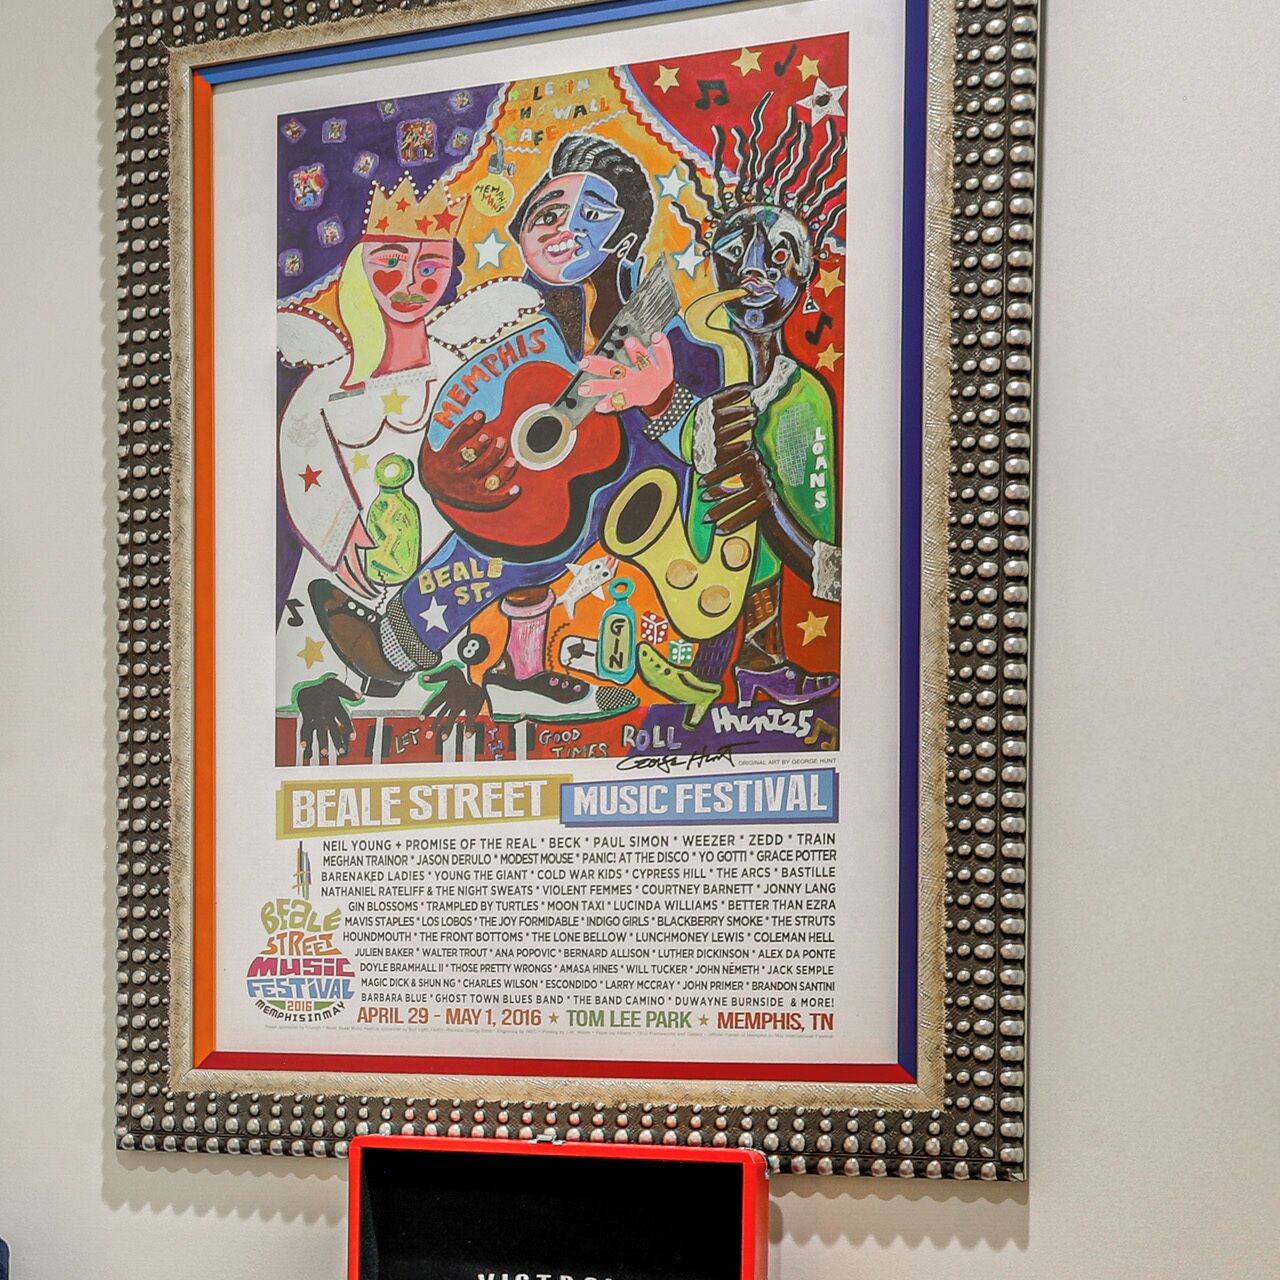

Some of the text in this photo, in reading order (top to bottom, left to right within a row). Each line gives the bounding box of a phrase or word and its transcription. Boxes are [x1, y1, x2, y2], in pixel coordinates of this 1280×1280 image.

[432, 328, 546, 429] MEMPHIS
[810, 426, 828, 509] LOANS
[418, 556, 504, 595] BEALE
[454, 582, 493, 606] ST.
[462, 639, 480, 659] 8
[609, 618, 627, 669] GIN
[394, 728, 421, 754] LET
[539, 725, 682, 751] GOOD ROLL
[292, 773, 828, 829] BEALE STREET MUSIC FESTIVAL
[322, 840, 348, 851] NEIL
[351, 840, 392, 851] YOUNG
[405, 839, 456, 850] PROMISE
[459, 839, 476, 849] OF
[479, 838, 502, 849] THE
[506, 838, 537, 849] REAL
[548, 837, 581, 848] BECK
[593, 836, 625, 848] PAUL
[629, 836, 669, 847] SIMON
[681, 835, 735, 847] WEEZER
[748, 834, 783, 846] ZEDD
[796, 834, 835, 845] TRAIN
[322, 849, 837, 866] MEGHAN TRAINOR JASON DERULO MODEST MOUSE PANIC! AT THE DISCO YO GOTTI GRACE POTTER
[321, 867, 836, 882] BARENAKED LADIES YOUNG THE GIANT COLD WAR KIDS CYPRESS HILL THE ARCS BASTILLE
[321, 886, 376, 897] NATHANIEL
[378, 886, 424, 896] RATELIFF
[435, 886, 455, 896] THE
[457, 885, 488, 896] NIGHT
[490, 885, 533, 896] SWEATS
[542, 885, 587, 895] VIOLENT
[589, 885, 632, 895] FEMMES
[641, 884, 700, 895] COURTNEY
[702, 884, 753, 895] BARNETT
[763, 884, 801, 894] JONNY
[804, 884, 836, 894] LANG
[348, 900, 836, 912] GIN BLOSSOMS TRAMPLED BY TURTLES MOON TAXI LUCINDA WILLIAMS BETTER THAN EZRA
[344, 916, 835, 927] MAVIS STAPLES LOS LOBOS THE JOY FORMIDABLE INDIGO GIRLS BLACKBERRY SMOKE THE STRUTS
[260, 931, 342, 956] STREET
[342, 932, 834, 942] HOUNDMOUTH THE FRONT BOTTOMS THE LONE BELLOW LUNCHMONEY LEWIS COLEMAN HELL
[287, 1000, 312, 1012] 2016
[361, 993, 403, 1003] BARBARA
[404, 994, 427, 1003] BLUE
[434, 994, 467, 1004] GHOST
[469, 994, 500, 1004] TOWN
[502, 995, 533, 1004] BLUES
[535, 995, 563, 1005] BAND
[572, 995, 592, 1005] THE
[594, 996, 622, 1005] BAND
[624, 996, 665, 1006] CAMINO
[674, 996, 728, 1006] DUWAYNE
[730, 997, 783, 1007] BURNSIDE
[800, 998, 834, 1008] MORE!
[357, 1007, 404, 1024] APRIL
[407, 1008, 429, 1024] 29
[445, 1008, 482, 1025] MAY
[485, 1009, 496, 1028] 1,
[501, 1009, 541, 1026] 2016
[566, 1010, 604, 1026] TOM
[609, 1010, 641, 1027] LEE
[645, 1011, 692, 1027] PARK
[717, 1011, 804, 1033] MEMPHIS,
[809, 1012, 833, 1029] TN
